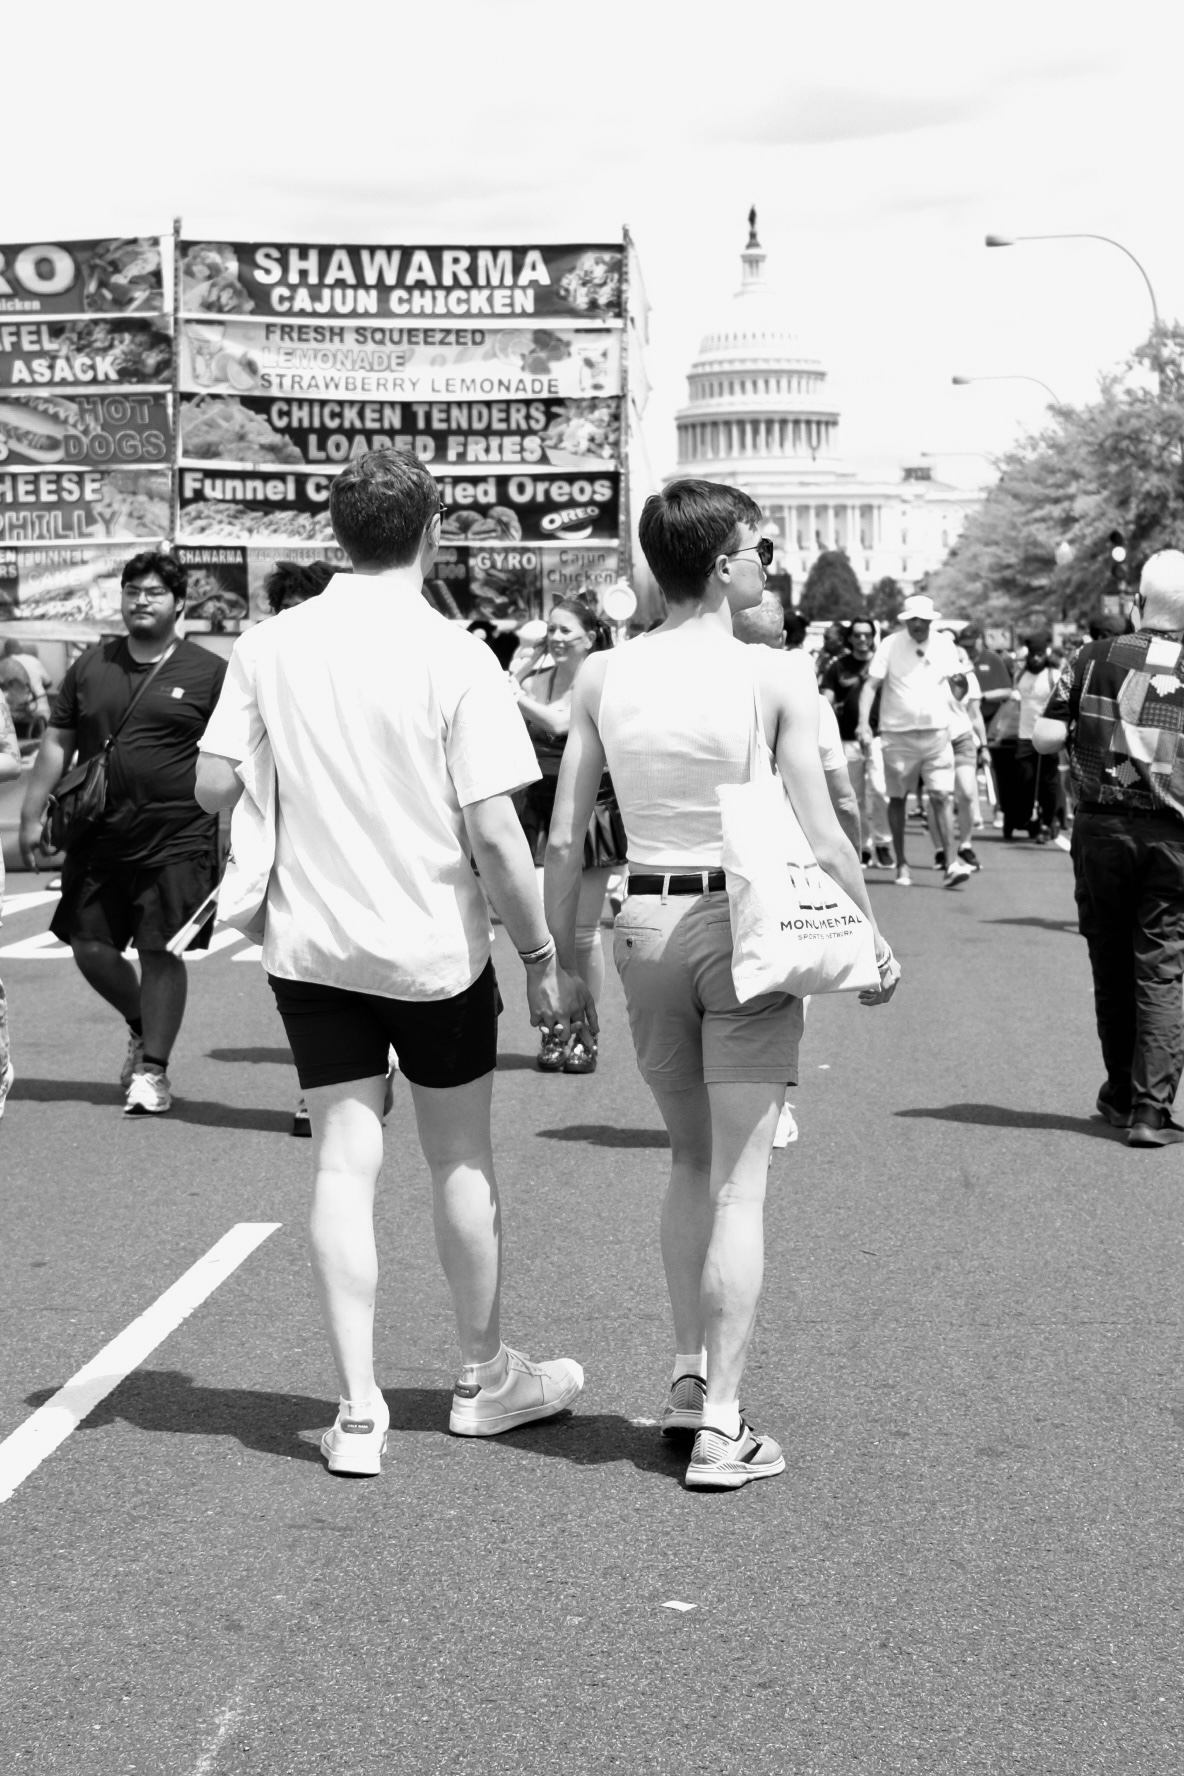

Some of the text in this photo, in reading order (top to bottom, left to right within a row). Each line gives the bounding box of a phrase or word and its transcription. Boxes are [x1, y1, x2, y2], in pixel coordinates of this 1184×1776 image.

[0, 244, 75, 295] O
[253, 246, 551, 287] SHAWARMA
[0, 299, 41, 311] icken
[270, 286, 535, 315] CAJUN CHICKEN
[0, 324, 60, 352] FEL
[264, 323, 486, 346] FRESH SQUEEZED
[262, 346, 406, 372] LEMONADE
[260, 373, 560, 395] STRAWBERRY LEMONADE
[76, 396, 154, 424] HOT
[270, 401, 546, 431] CHICKEN TENDERS
[63, 429, 167, 461] DOGS
[447, 434, 543, 462] FRIES
[183, 471, 296, 501] Funnel
[508, 475, 613, 503] Oreos
[0, 510, 122, 541] HILLY
[541, 505, 599, 531] OREO
[22, 549, 89, 566] FUNNEL
[179, 549, 244, 564] SHAWARMA
[476, 552, 537, 570] GYRO
[559, 550, 606, 569] Cajun
[546, 569, 613, 584] Chicken
[780, 914, 863, 932] MONUMENTAL
[797, 932, 825, 941] SPORTS
